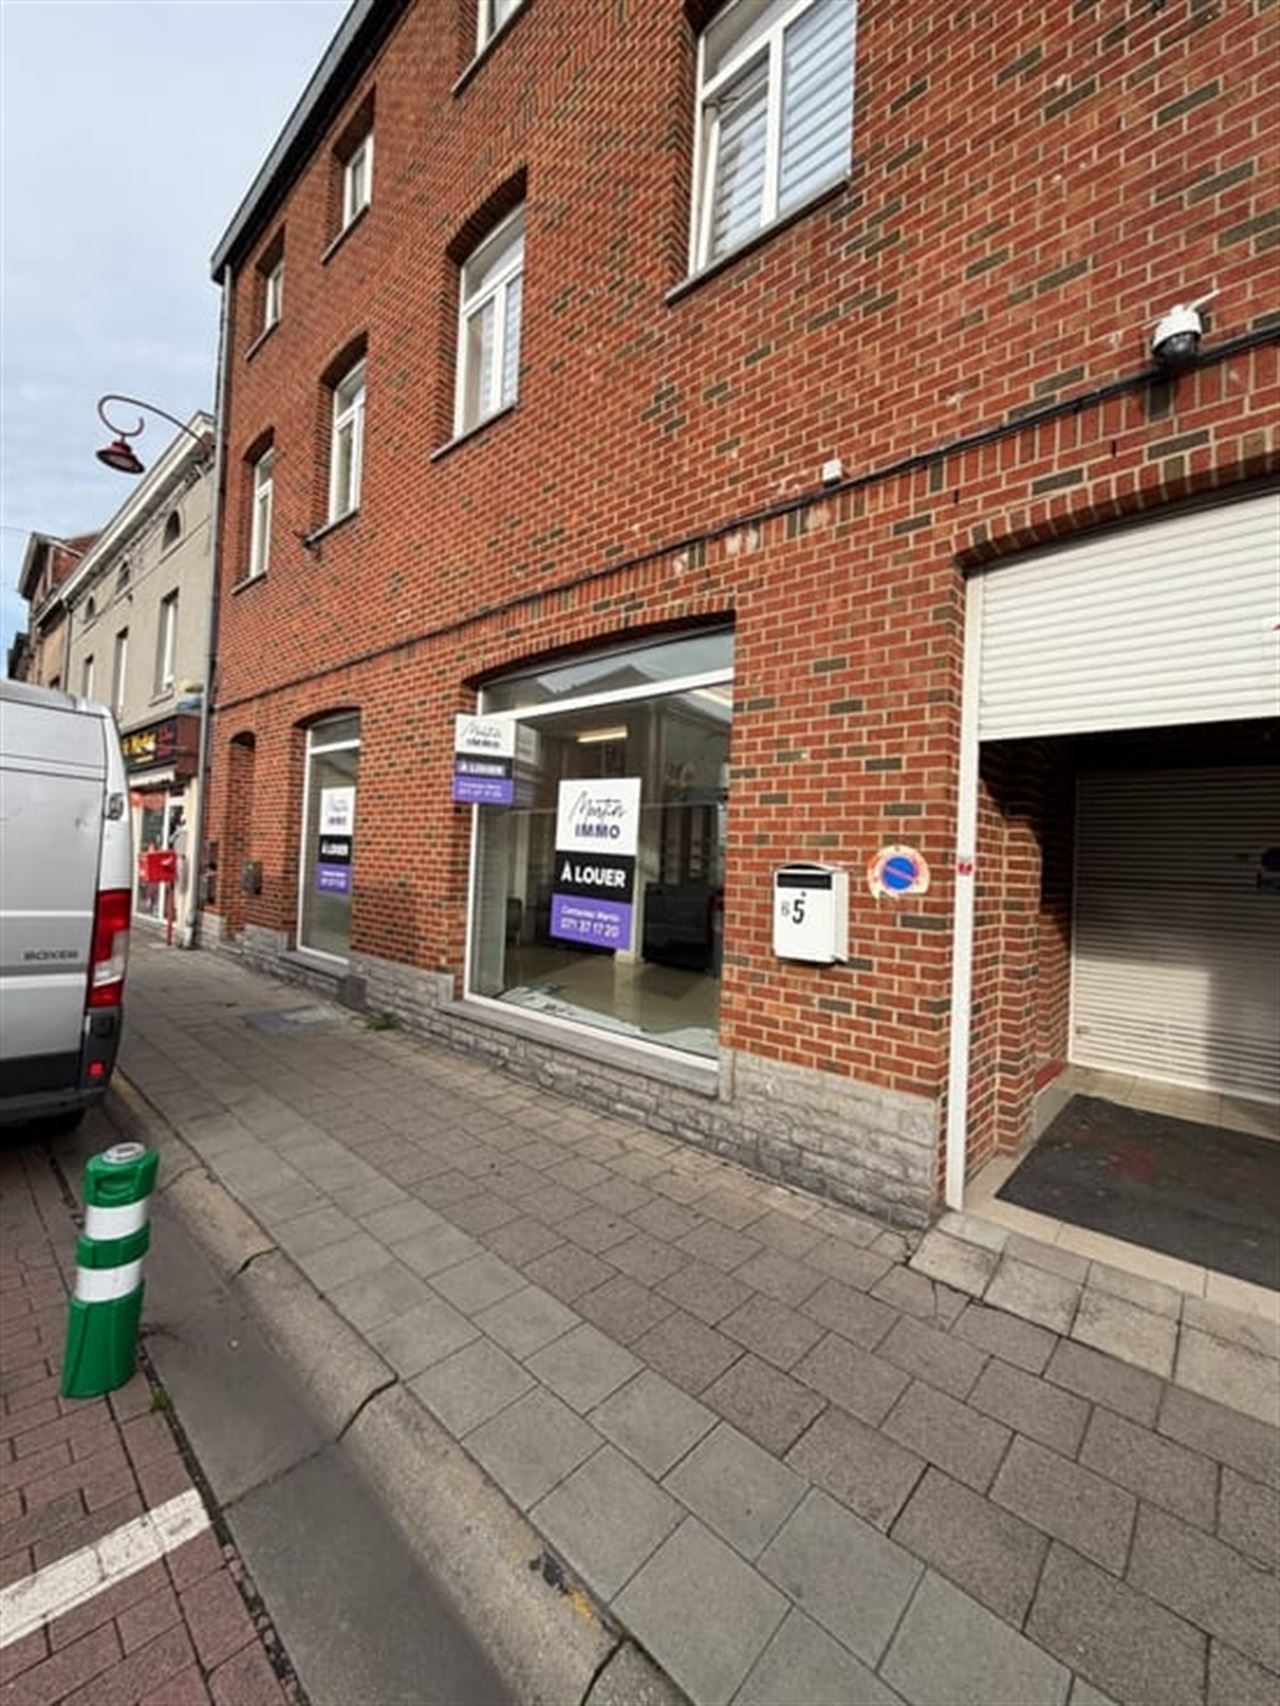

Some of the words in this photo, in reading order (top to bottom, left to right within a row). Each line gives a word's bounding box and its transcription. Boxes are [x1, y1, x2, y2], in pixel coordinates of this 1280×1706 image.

[567, 790, 627, 824] Martin
[575, 824, 621, 839] IMMO
[574, 865, 627, 888] LOUER
[792, 898, 806, 925] 5
[24, 949, 79, 961] BOXER
